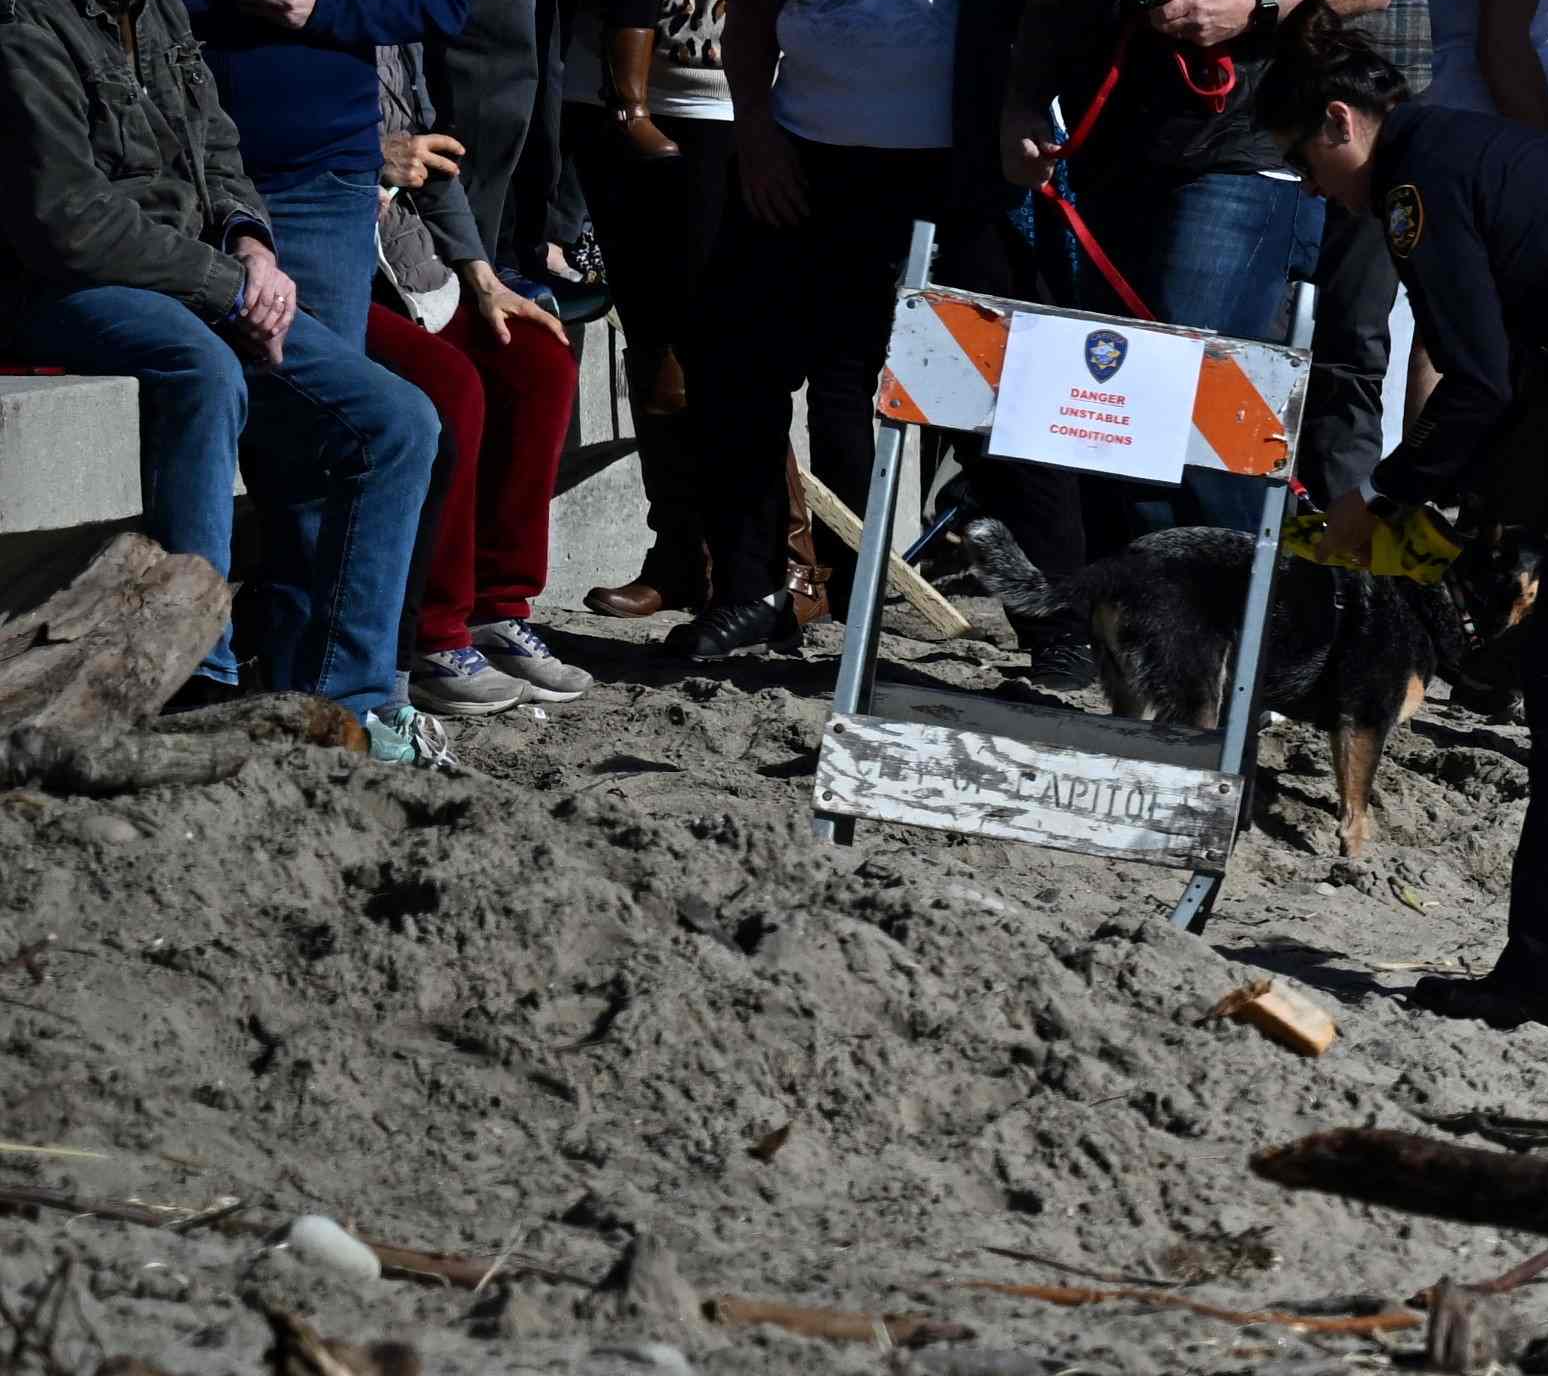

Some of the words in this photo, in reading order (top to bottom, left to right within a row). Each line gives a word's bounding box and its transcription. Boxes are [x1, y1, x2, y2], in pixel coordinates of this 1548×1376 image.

[1070, 387, 1126, 405] DANGER
[1059, 406, 1131, 425] UNSTABLE
[1049, 424, 1133, 445] CONDITIONS
